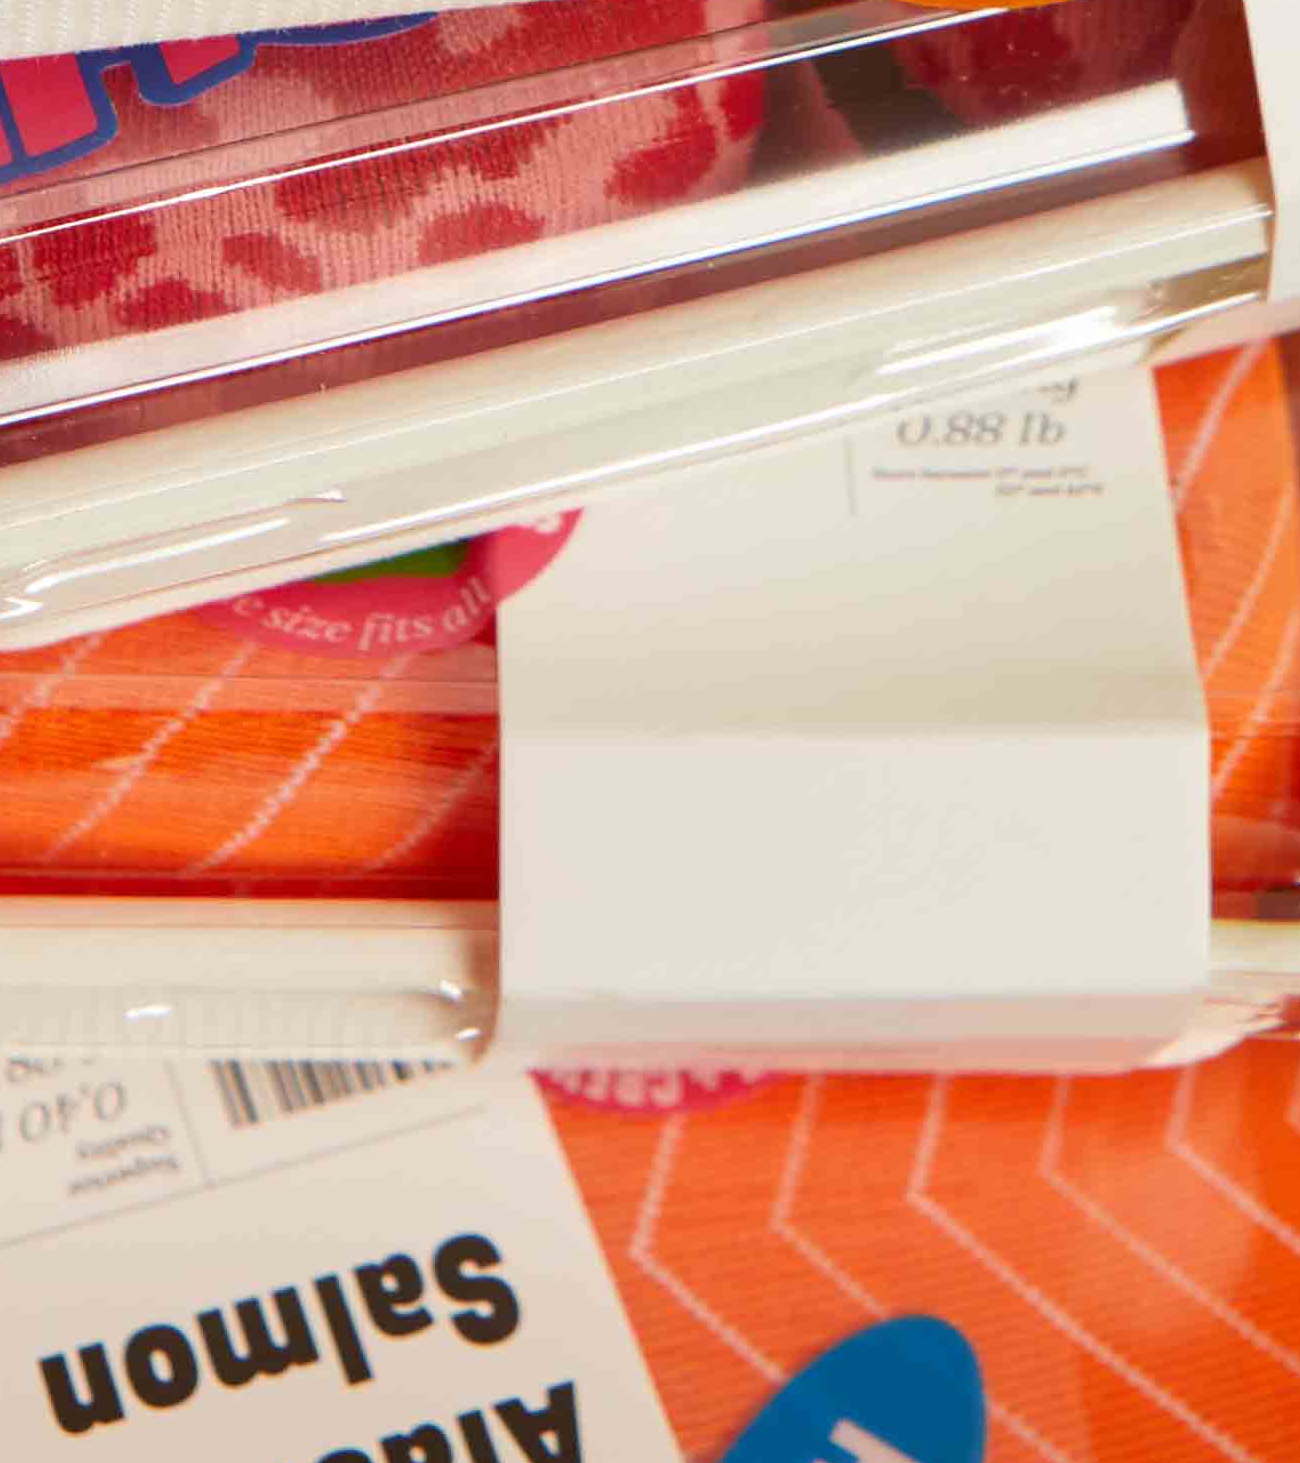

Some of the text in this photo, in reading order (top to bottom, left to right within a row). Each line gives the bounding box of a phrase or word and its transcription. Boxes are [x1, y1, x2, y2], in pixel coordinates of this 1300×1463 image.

[262, 577, 492, 651] size fits all
[38, 1232, 521, 1435] Salmon
